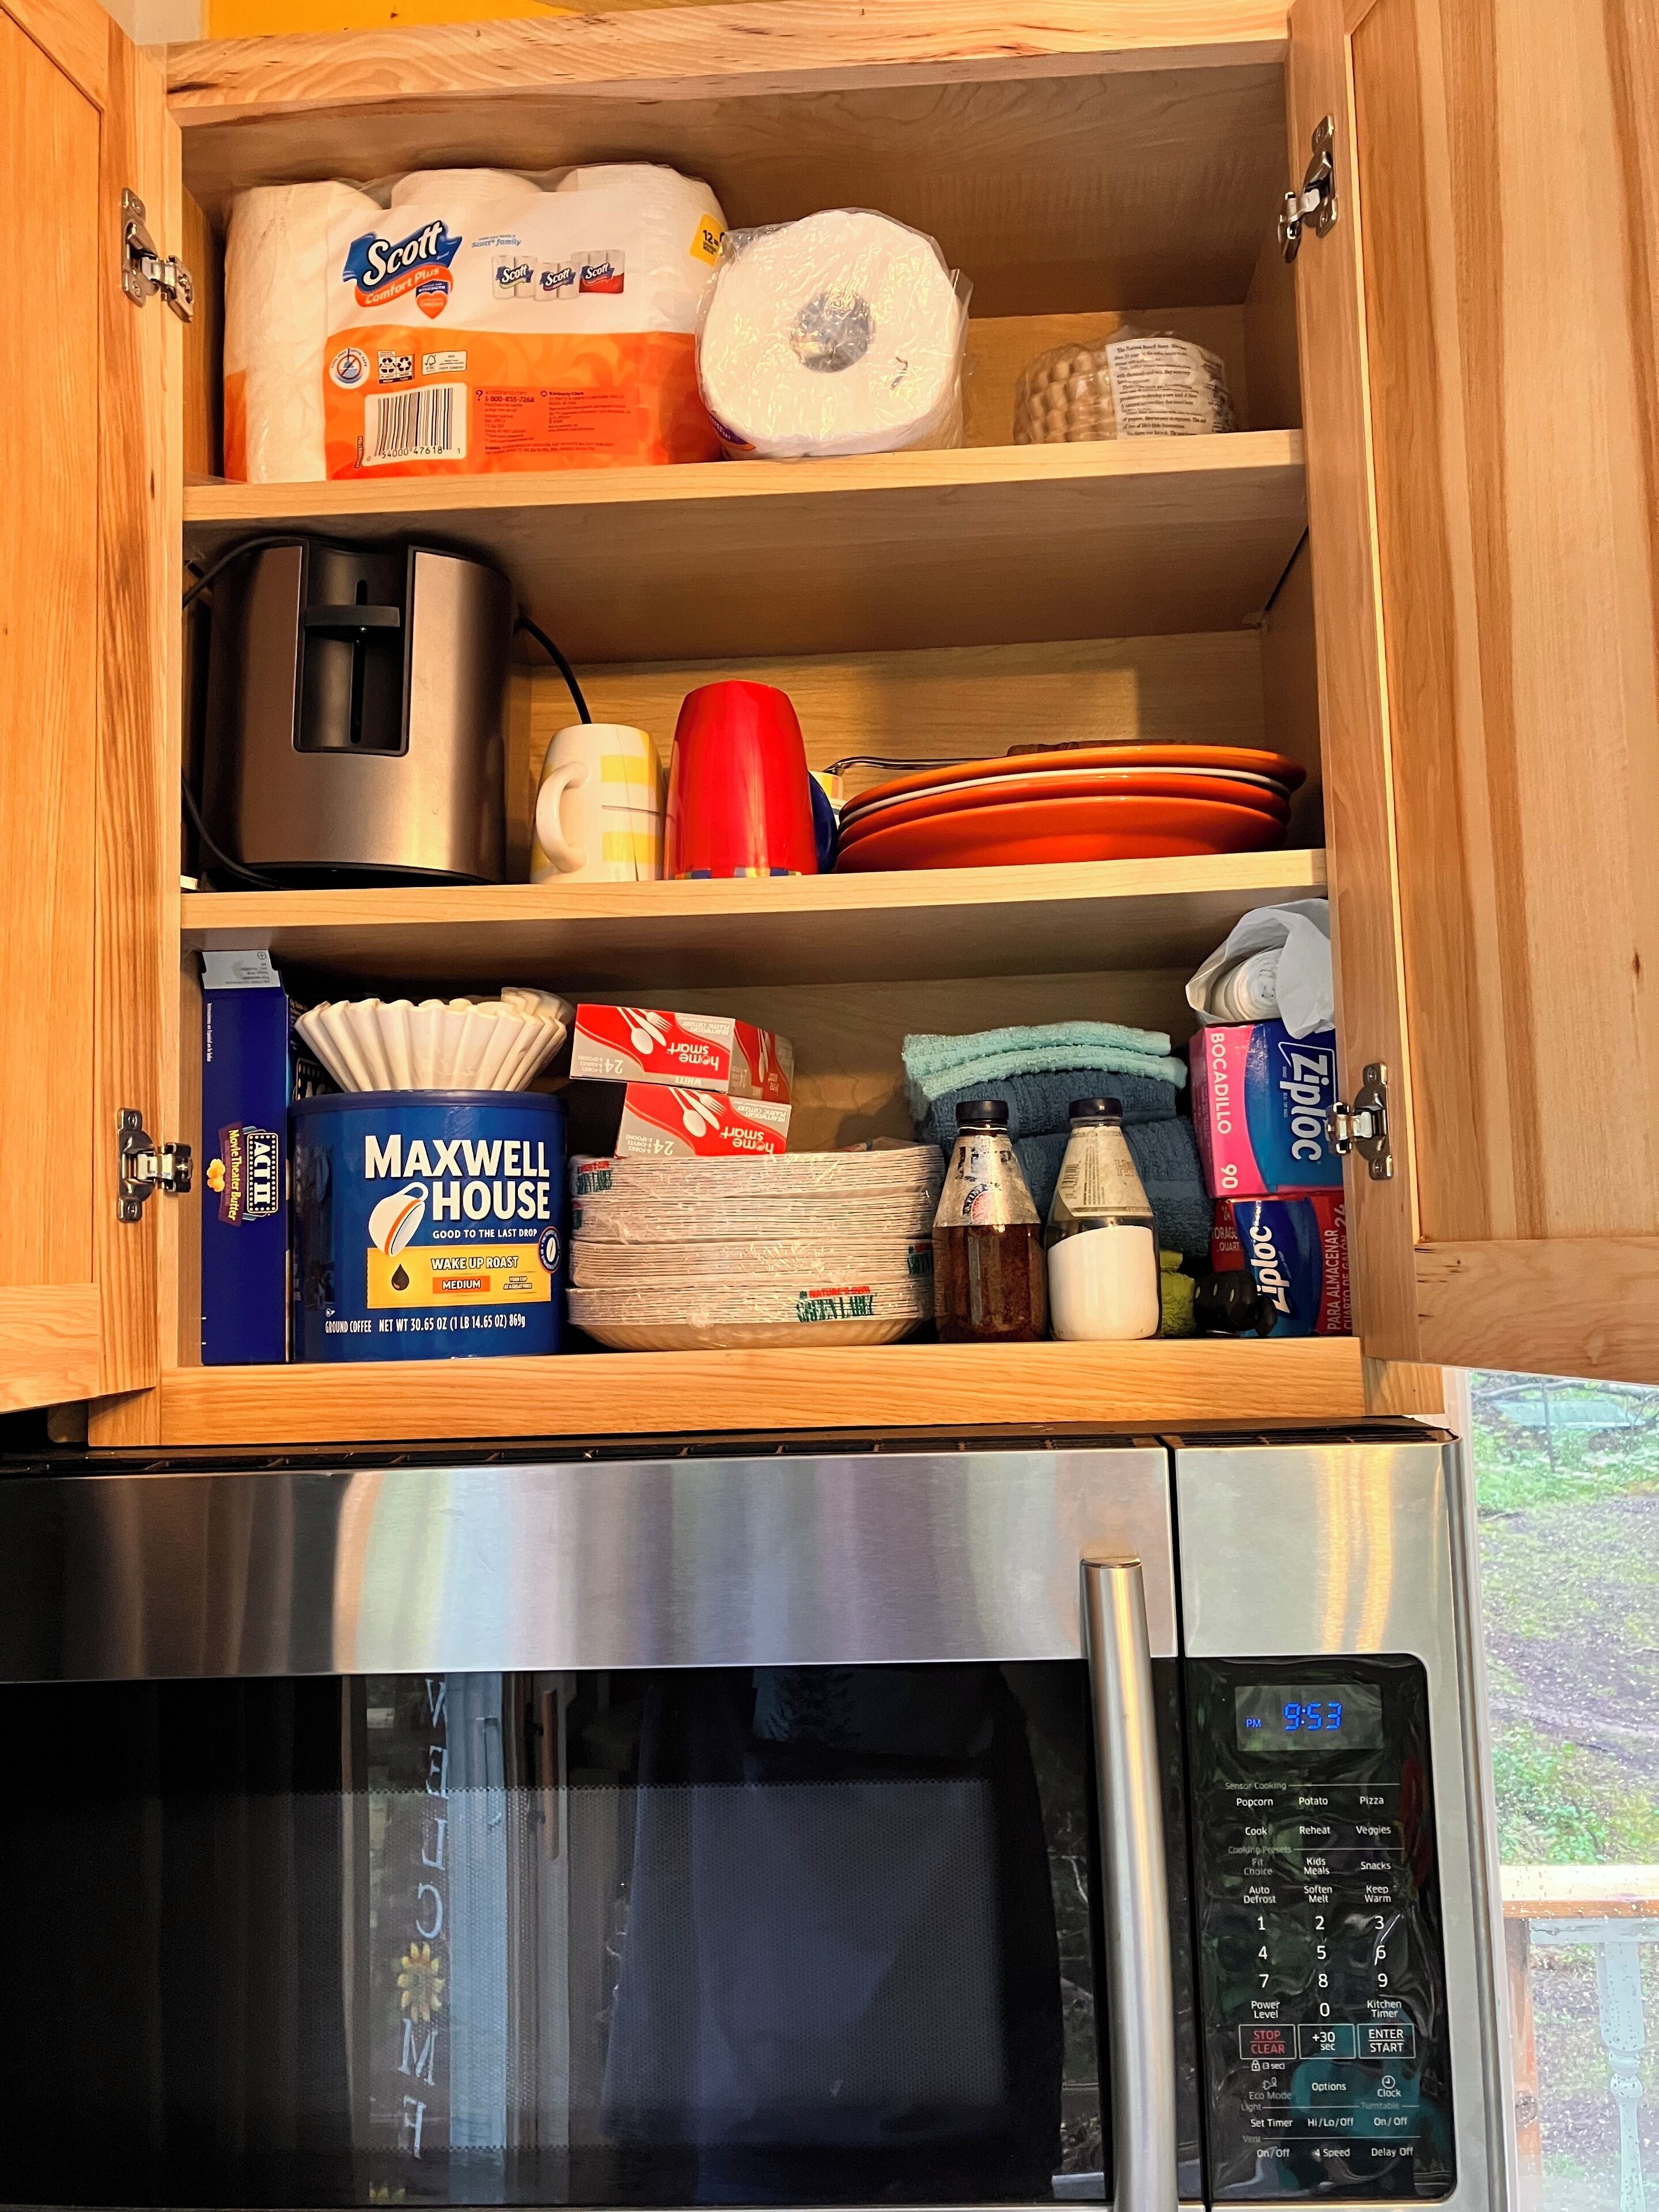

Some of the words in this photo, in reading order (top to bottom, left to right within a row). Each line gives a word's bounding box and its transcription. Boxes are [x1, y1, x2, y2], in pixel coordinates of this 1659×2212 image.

[496, 238, 521, 247] family
[363, 221, 442, 286] Scott
[501, 263, 528, 282] Scott
[585, 262, 609, 279] Scott
[545, 267, 571, 286] Scott
[366, 278, 412, 305] Comfort
[414, 267, 440, 284] Plus
[382, 447, 409, 459] 54000
[414, 446, 443, 455] 47618
[682, 1020, 705, 1028] CUTLERY
[706, 1022, 729, 1031] PLASTIC
[690, 1026, 729, 1036] HEAVYWEIGHT
[668, 1043, 710, 1055] smart
[605, 1059, 623, 1074] 24
[679, 1053, 719, 1071] home
[674, 1077, 702, 1086] WHITE
[1210, 1032, 1232, 1134] BOCADILLO
[1221, 1164, 1238, 1189] 90
[1280, 1053, 1329, 1161] Ziploc
[745, 1111, 786, 1122] HEAVYWEIGHT
[763, 1109, 787, 1117] PLASTIC
[720, 1127, 764, 1141] smart
[228, 1129, 241, 1157] Movie
[654, 1139, 675, 1156] 24
[732, 1138, 774, 1154] home
[254, 1142, 271, 1179] ACT
[365, 1134, 550, 1179] MAXWELL
[231, 1156, 242, 1191] Theater
[254, 1182, 271, 1205] II
[433, 1181, 550, 1221] HOUSE
[228, 1192, 241, 1221] Butter
[1334, 1205, 1347, 1228] 24
[433, 1229, 461, 1238] GOOD
[463, 1229, 476, 1238] TO
[479, 1229, 495, 1238] THE
[498, 1229, 517, 1237] LAST
[519, 1229, 537, 1237] DROP
[431, 1258, 467, 1270] WAKE
[468, 1257, 484, 1269] UP
[486, 1256, 518, 1268] ROAST
[1325, 1229, 1340, 1297] ALMACENAR
[442, 1279, 481, 1290] MEDIUM
[1327, 1301, 1341, 1330] PARA
[325, 1320, 348, 1333] GROUND
[350, 1320, 372, 1333] COFFEE
[379, 1319, 393, 1332] NET
[396, 1319, 408, 1332] WT
[410, 1318, 434, 1332] 30.65
[437, 1317, 447, 1330] OZ
[450, 1317, 457, 1331] (1
[460, 1316, 469, 1329] LB
[472, 1315, 493, 1328] 14.65
[494, 1314, 507, 1330] OZ)
[509, 1313, 525, 1328] 869g
[1246, 1719, 1262, 1728] PM
[1284, 1702, 1342, 1730] 9:53
[1255, 1782, 1287, 1791] Cooking
[1236, 1797, 1274, 1807] Popcorn
[1298, 1797, 1328, 1805] Potato
[1359, 1796, 1384, 1805] Pizza
[1245, 1827, 1267, 1836] Cook
[1300, 1826, 1331, 1834] Reheat
[1356, 1825, 1392, 1835] Veggies
[1228, 1846, 1260, 1855] Cooking
[1252, 1857, 1264, 1866] Fit
[1306, 1857, 1326, 1866] Kids
[1361, 1861, 1392, 1870] Snacks
[1243, 1867, 1273, 1876] Choice
[1304, 1866, 1330, 1875] Meals
[1249, 1886, 1270, 1895] Auto
[1304, 1885, 1333, 1894] Soften
[1366, 1885, 1389, 1896] Keep
[1243, 1895, 1276, 1904] Defrost
[1309, 1894, 1329, 1903] Melt
[1364, 1894, 1392, 1903] Warm
[1257, 1916, 1266, 1930] 1
[1315, 1916, 1325, 1930] 2
[1374, 1916, 1384, 1930] 3
[1258, 1946, 1268, 1960] 4
[1317, 1945, 1326, 1960] 5
[1377, 1945, 1386, 1959] 6
[1259, 1974, 1268, 1988] 7
[1319, 1974, 1328, 1987] 8
[1378, 1974, 1388, 1987] 9
[1251, 2000, 1280, 2009] Power
[1367, 2000, 1402, 2009] Kitchen
[1253, 2009, 1278, 2018] Level
[1319, 2003, 1330, 2017] 0
[1372, 2009, 1398, 2018] Timer
[1253, 2030, 1281, 2040] STOP
[1312, 2032, 1335, 2043] +30
[1369, 2029, 1404, 2039] ENTER
[1251, 2044, 1285, 2054] CLEAR
[1320, 2043, 1335, 2051] sec
[1370, 2043, 1403, 2053] START
[1263, 2062, 1270, 2070] (3
[1271, 2062, 1286, 2071] sec)
[1312, 2082, 1347, 2092] Options
[1249, 2092, 1265, 2100] Eco
[1267, 2091, 1292, 2100] Mode
[1377, 2089, 1401, 2098] Clock
[1241, 2103, 1262, 2112] Light
[1361, 2101, 1400, 2111] Turntable
[1251, 2119, 1264, 2127] Set
[1267, 2119, 1293, 2127] Timer
[1374, 2118, 1408, 2127] On/Off
[1243, 2135, 1261, 2143] Vent
[1257, 2148, 1290, 2158] On/Off
[1315, 2149, 1320, 2157] 4
[1323, 2149, 1350, 2158] Speed
[1371, 2147, 1396, 2158] Delay
[1399, 2147, 1414, 2156] Off
